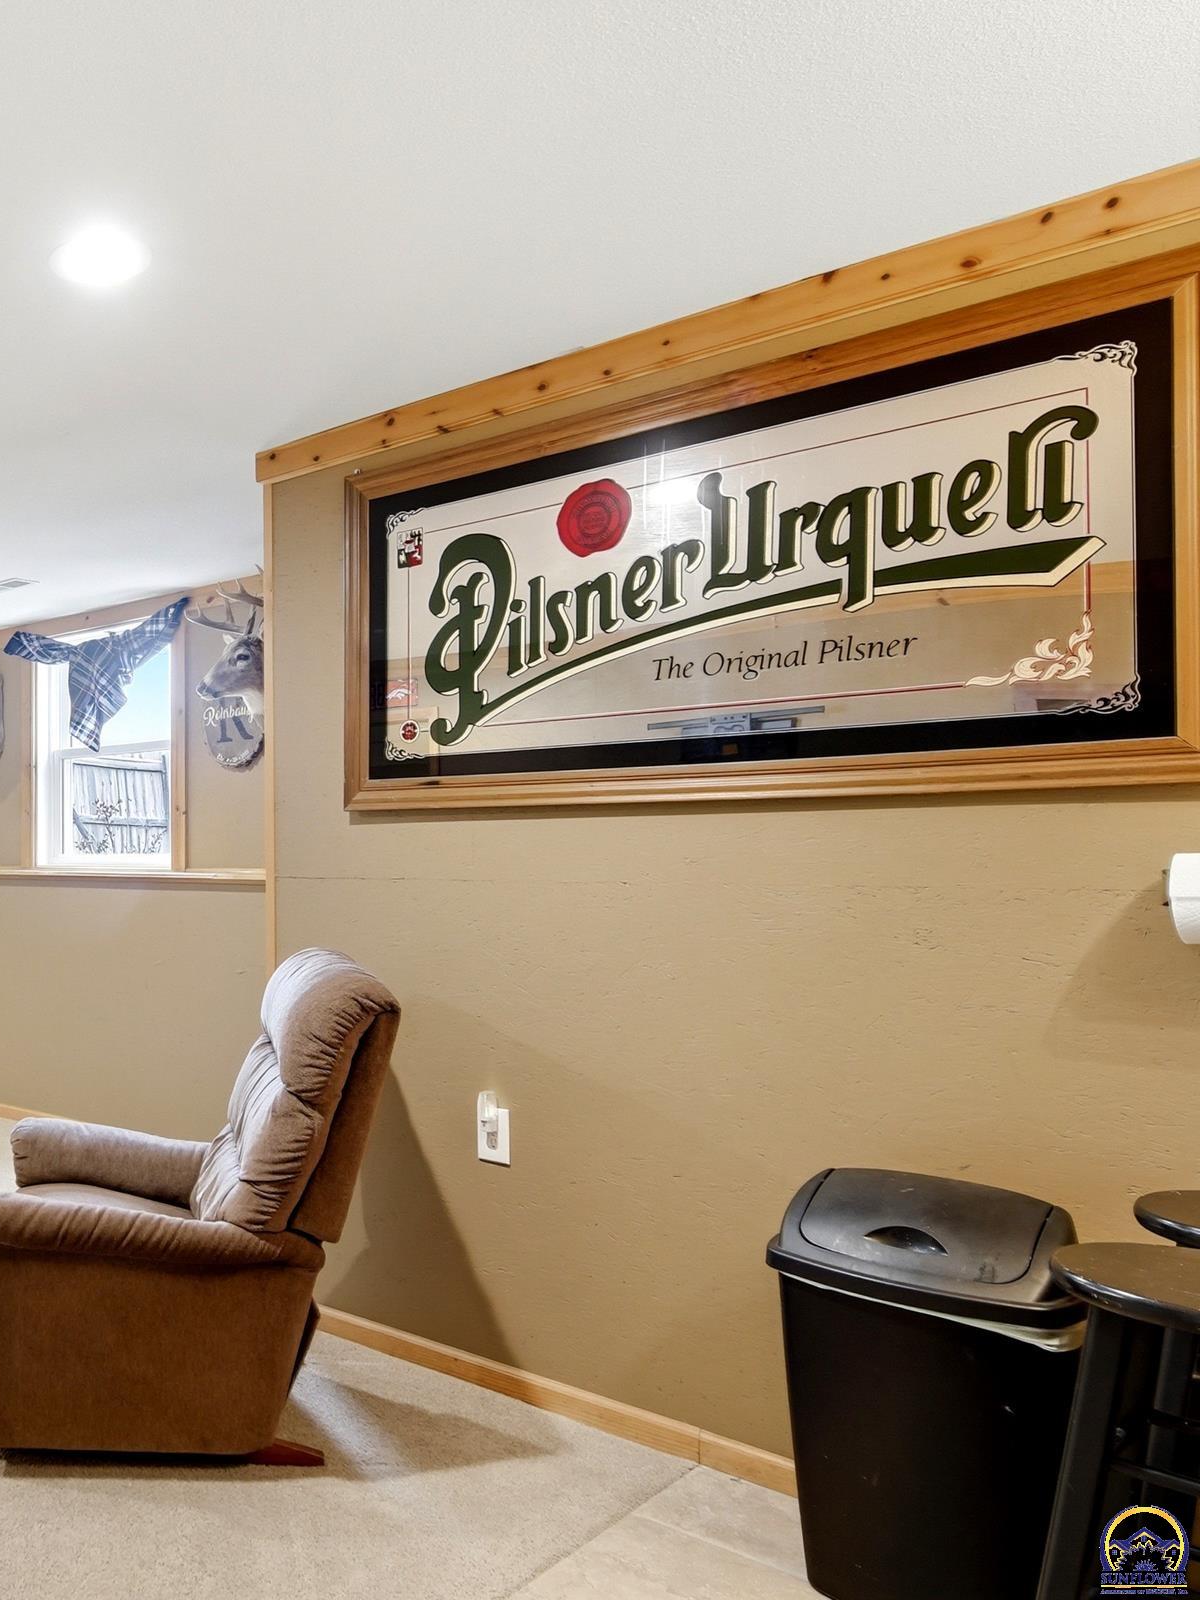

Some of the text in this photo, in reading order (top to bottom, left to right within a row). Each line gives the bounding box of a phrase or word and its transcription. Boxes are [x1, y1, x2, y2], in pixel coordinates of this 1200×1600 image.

[425, 405, 1099, 746] Pilsner Urquell
[652, 635, 918, 681] The Original Pilsner
